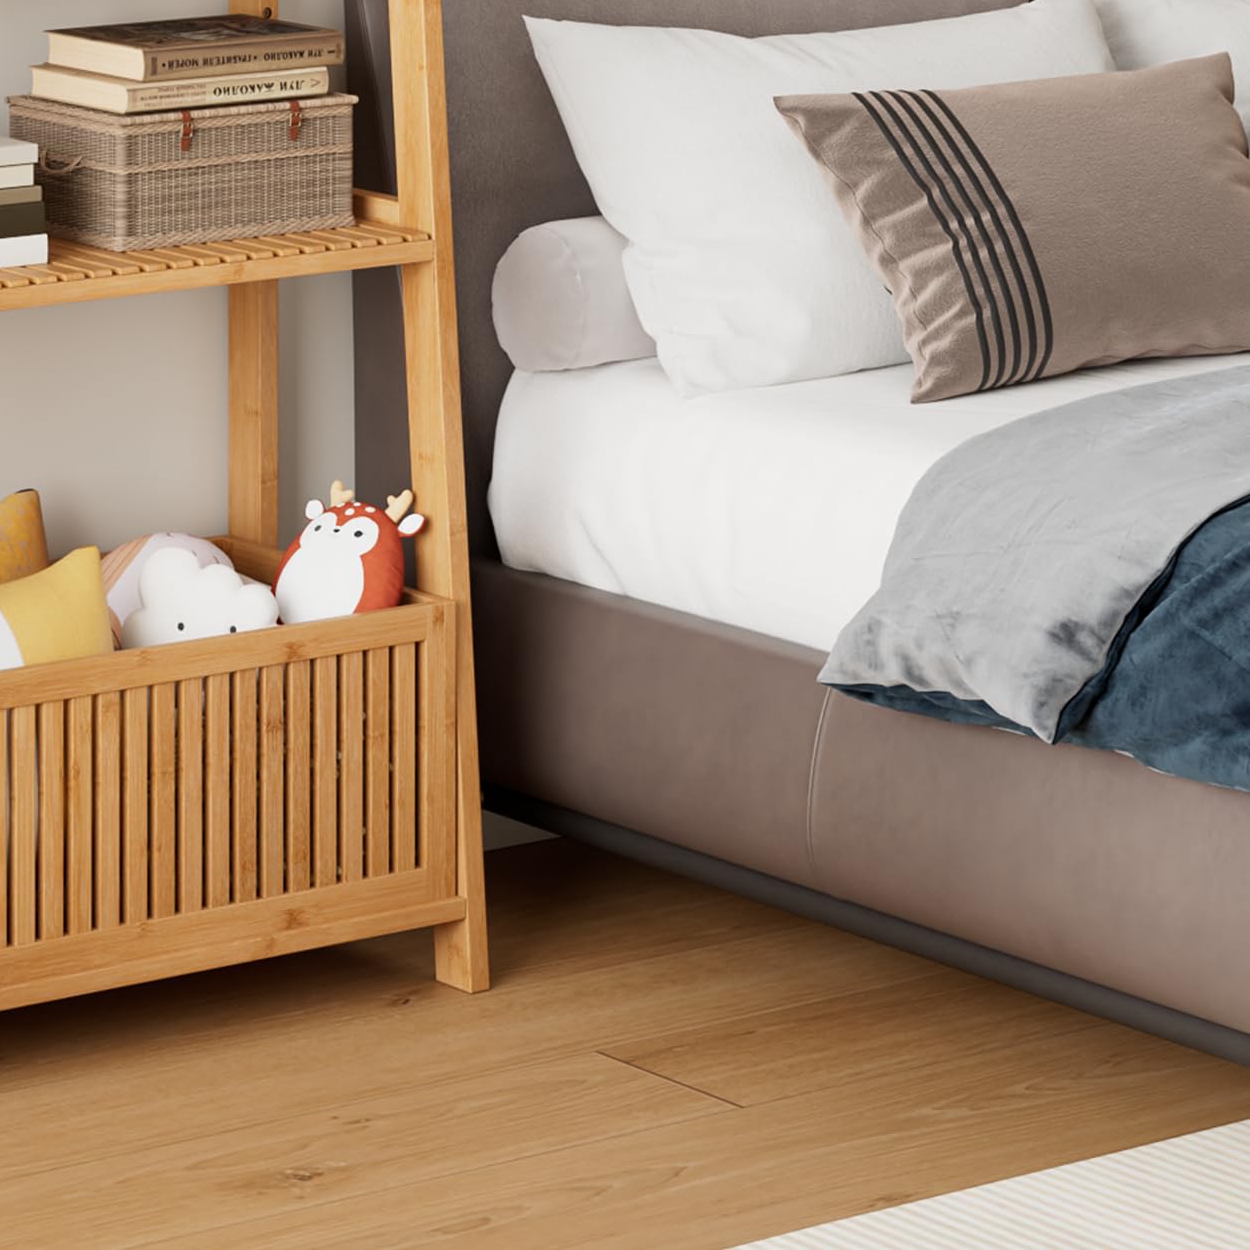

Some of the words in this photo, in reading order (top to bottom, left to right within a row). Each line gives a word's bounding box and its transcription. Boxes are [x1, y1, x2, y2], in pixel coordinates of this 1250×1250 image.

[168, 58, 199, 70] МОРЕЙ
[213, 81, 275, 96] ЖАКОЛИО
[280, 79, 305, 91] ЛУИ
